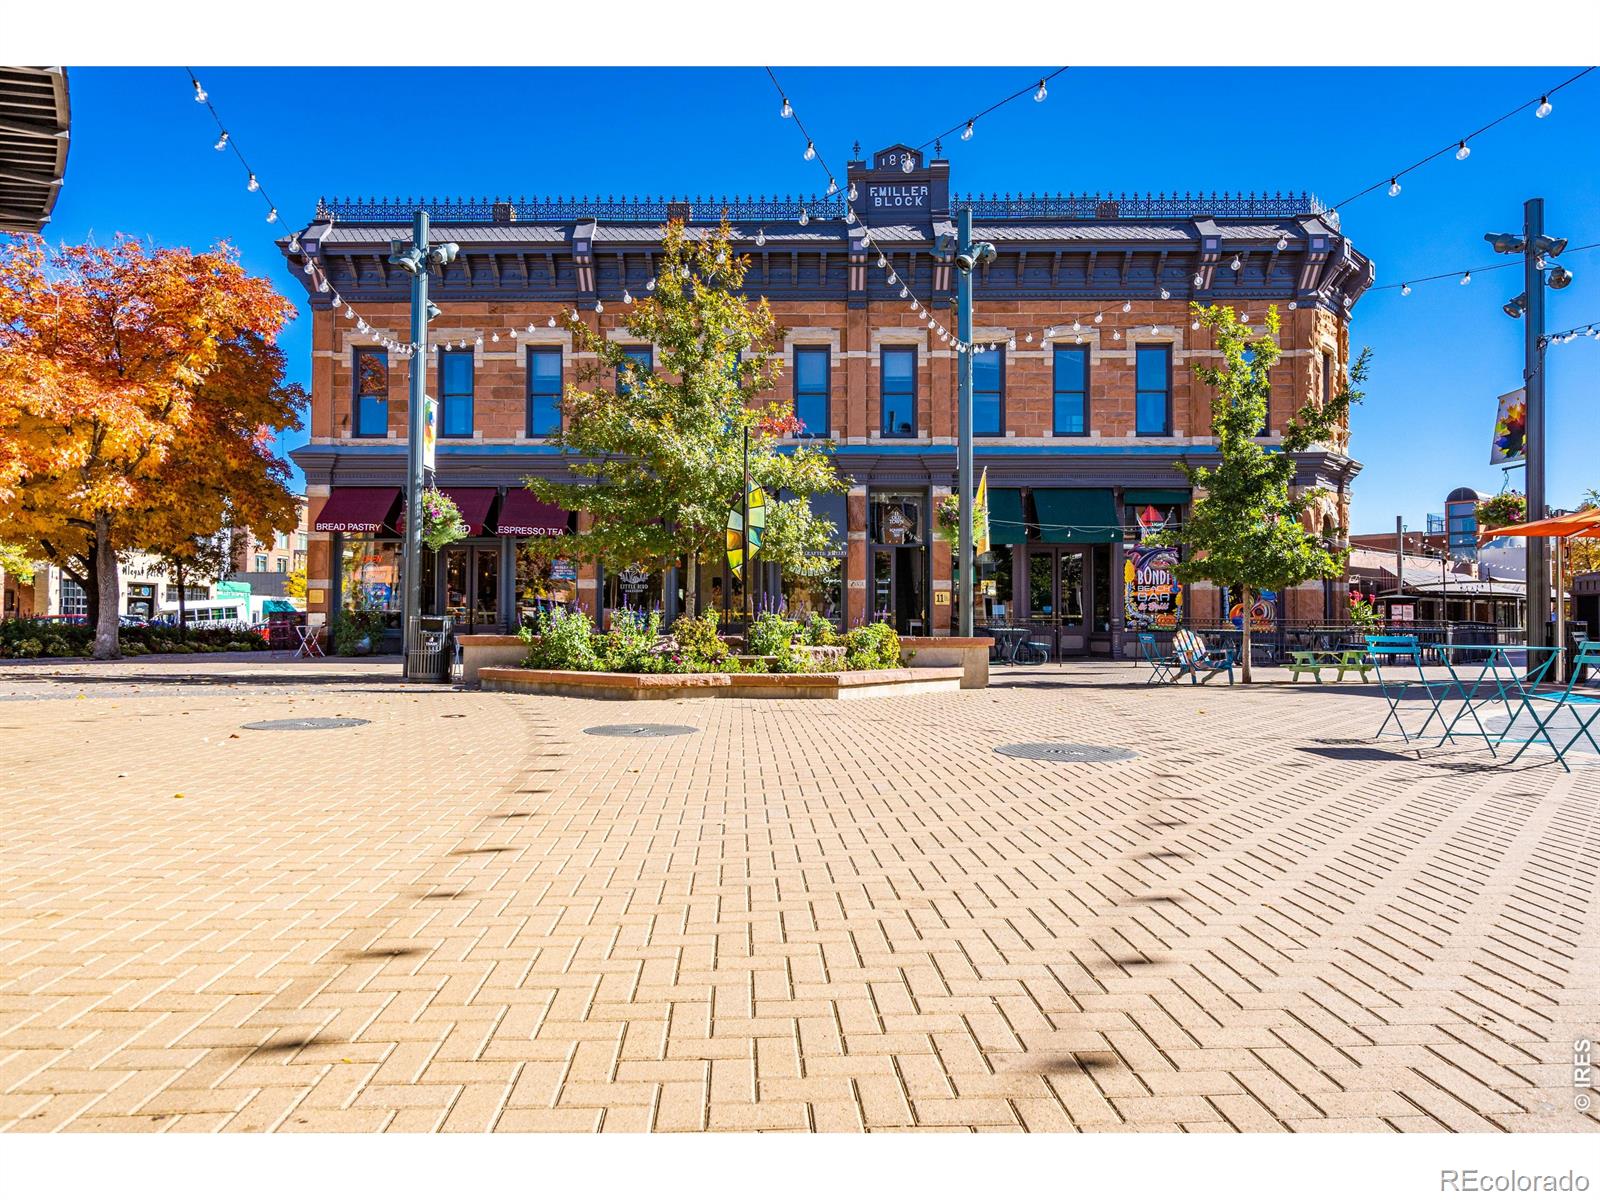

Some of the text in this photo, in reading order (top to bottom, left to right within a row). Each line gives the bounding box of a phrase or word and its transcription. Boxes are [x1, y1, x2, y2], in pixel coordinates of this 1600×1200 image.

[870, 186, 928, 197] F.MILLER
[874, 196, 923, 207] BLOCK
[316, 522, 381, 531] BREAD PASTRY
[498, 525, 564, 536] ESPRESSO TEA
[1137, 592, 1170, 602] BAR
